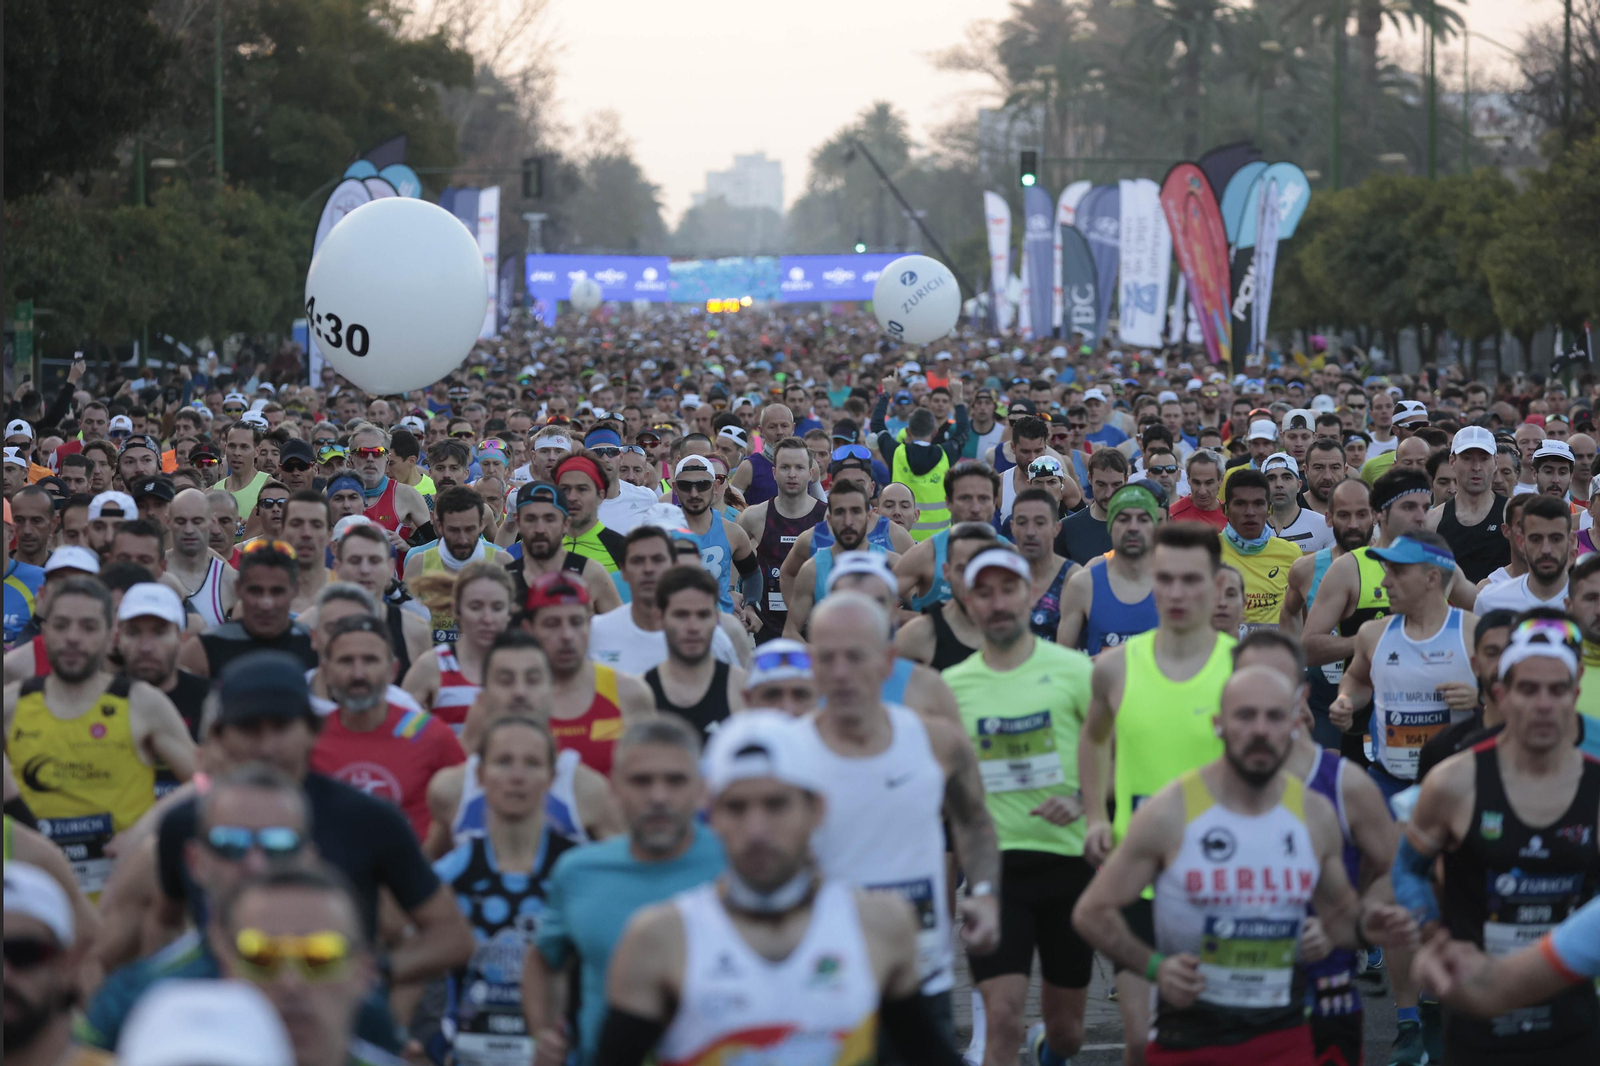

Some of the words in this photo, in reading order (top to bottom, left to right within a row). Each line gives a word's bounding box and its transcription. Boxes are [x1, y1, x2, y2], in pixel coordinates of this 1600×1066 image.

[901, 276, 945, 314] ZURICH
[306, 296, 370, 357] 4:30
[1383, 692, 1404, 701] BLUE
[1406, 692, 1432, 702] MARLIN
[1404, 713, 1442, 724] ZURICH
[54, 820, 104, 834] ZURICH
[1186, 868, 1312, 893] BERLIN
[1518, 878, 1574, 894] ZURICH
